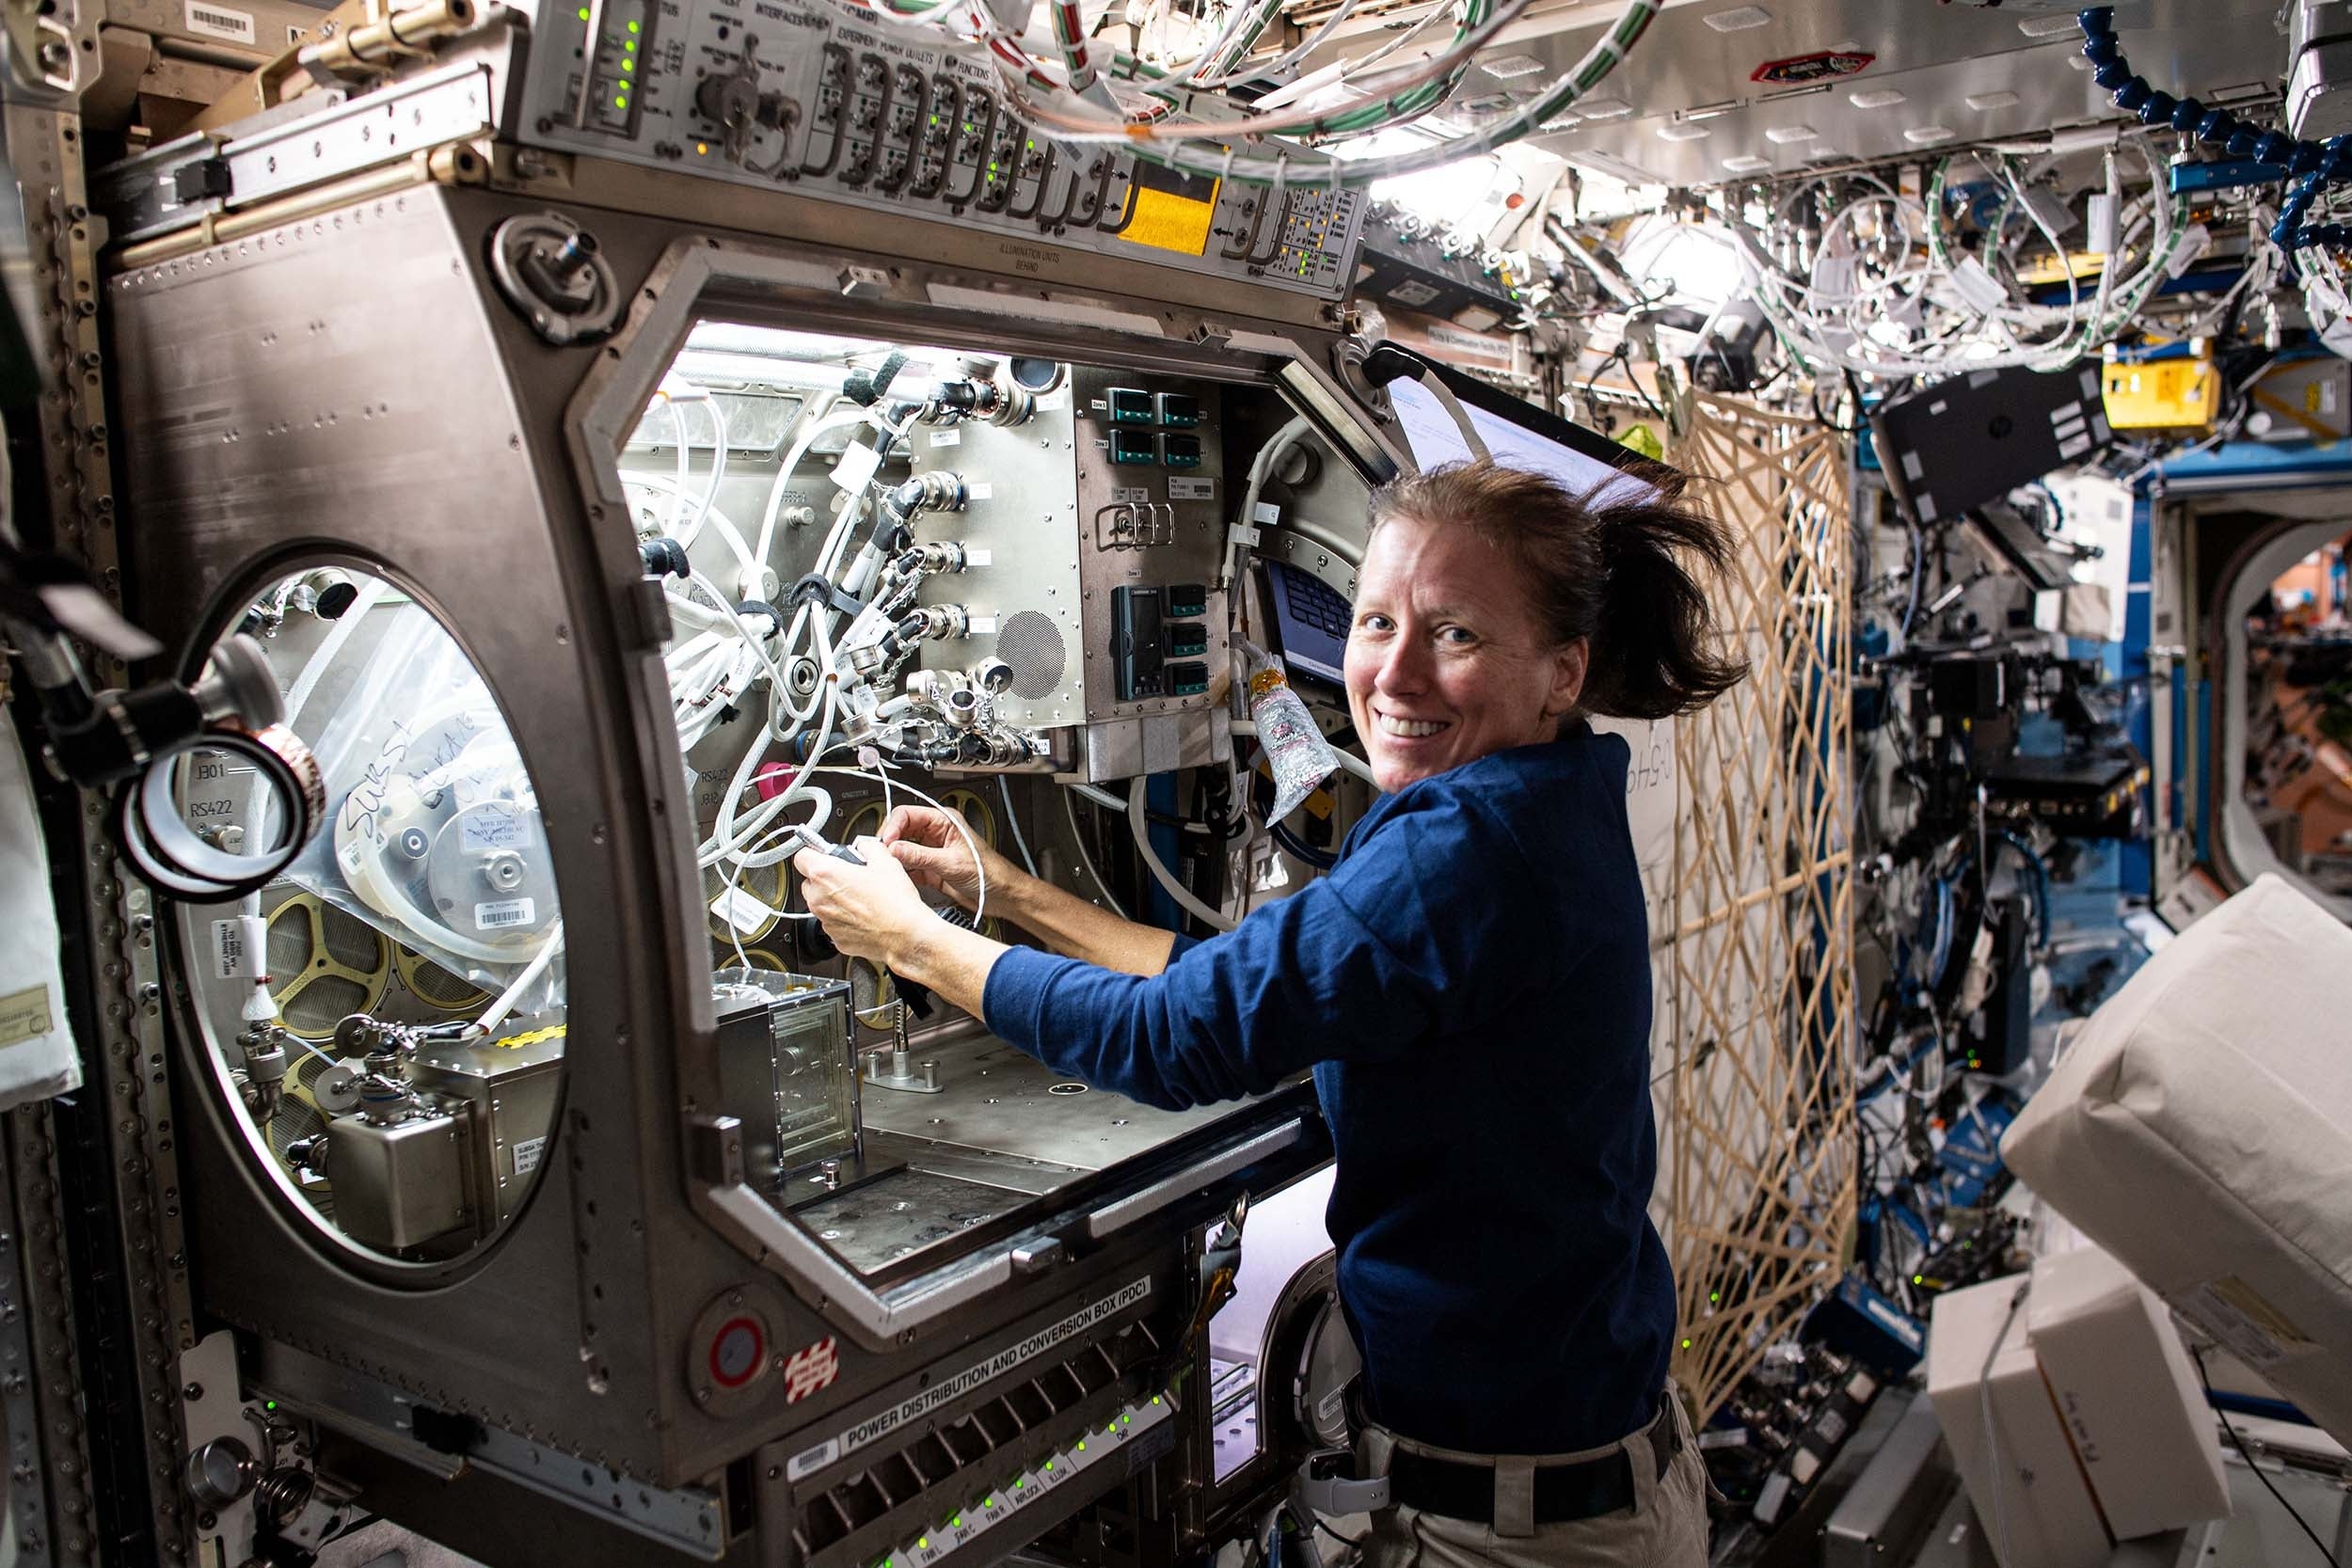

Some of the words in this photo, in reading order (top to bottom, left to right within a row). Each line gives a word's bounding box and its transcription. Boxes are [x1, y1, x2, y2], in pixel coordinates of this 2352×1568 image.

[906, 48, 933, 65] OUTLETS
[958, 61, 991, 81] FUNCTIONS
[999, 243, 1041, 261] ILLUMINATION
[1041, 250, 1061, 264] UNITS
[1015, 260, 1040, 273] BEHIND
[701, 768, 728, 784] RS422
[190, 800, 232, 817] RS422
[220, 924, 230, 959] ETHERNET
[228, 931, 235, 940] TO
[849, 1411, 899, 1448] POWER
[902, 1366, 989, 1418] DISTRIBUTION
[992, 1351, 1017, 1374] AND
[1020, 1310, 1092, 1358] CONVERSION
[1093, 1297, 1117, 1323] BOX
[1118, 1282, 1146, 1308] (PDC)
[1015, 1484, 1041, 1505] AIRLOCK
[985, 1510, 999, 1524] FAN
[954, 1528, 968, 1544] FAN
[920, 1547, 936, 1563] FAN
